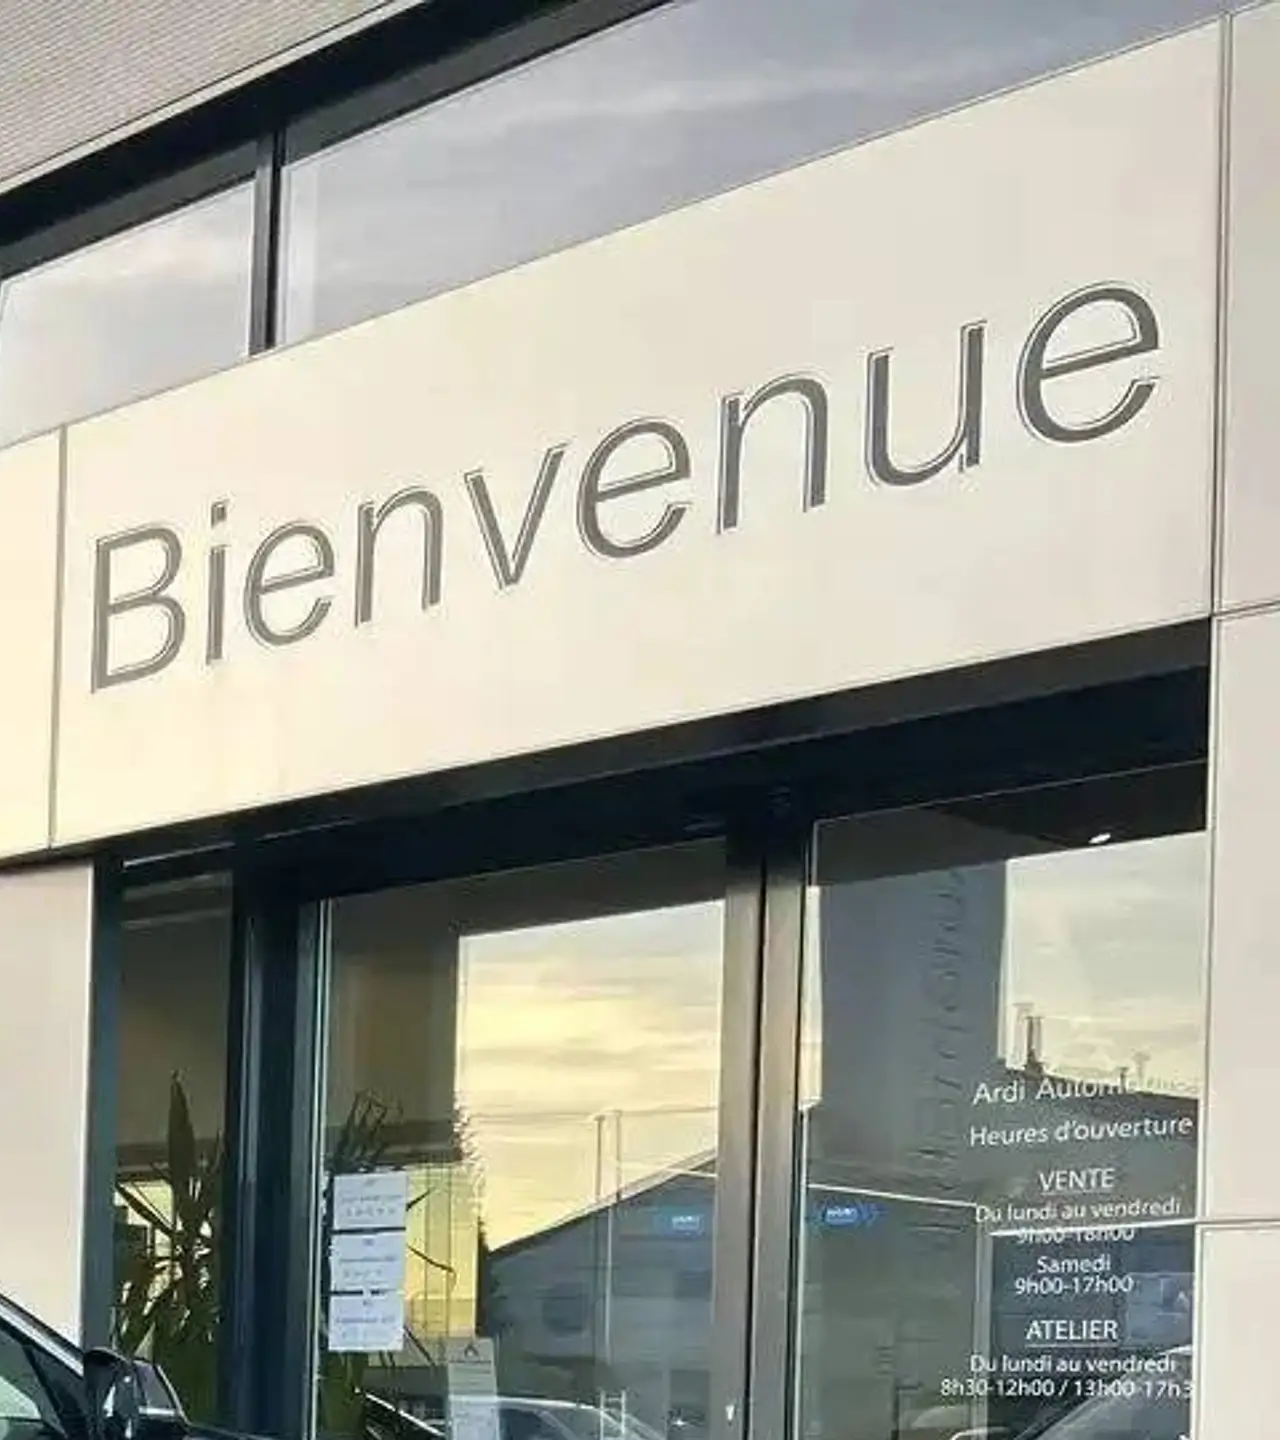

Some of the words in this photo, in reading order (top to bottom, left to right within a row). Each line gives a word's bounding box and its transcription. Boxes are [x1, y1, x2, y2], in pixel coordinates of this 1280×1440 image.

[89, 279, 1162, 694] Bienvenue
[972, 1079, 1026, 1105] Ardi
[969, 1125, 1048, 1147] Heures
[1054, 1116, 1194, 1141] d'ouverture
[1040, 1168, 1115, 1191] VENTE
[975, 1204, 1001, 1222] Du
[1007, 1203, 1058, 1221] lundi
[1061, 1203, 1086, 1218] au
[1089, 1195, 1181, 1217] vendredi
[1036, 1254, 1112, 1274] Samedi
[1014, 1273, 1135, 1296] 9h00-17h00
[1025, 1320, 1119, 1341] ATELIER
[970, 1355, 997, 1372] Du
[1002, 1354, 1052, 1372] lundi
[1056, 1359, 1081, 1372] au
[1086, 1354, 1176, 1373] vendredi
[940, 1378, 1055, 1397] 8h30-12h00
